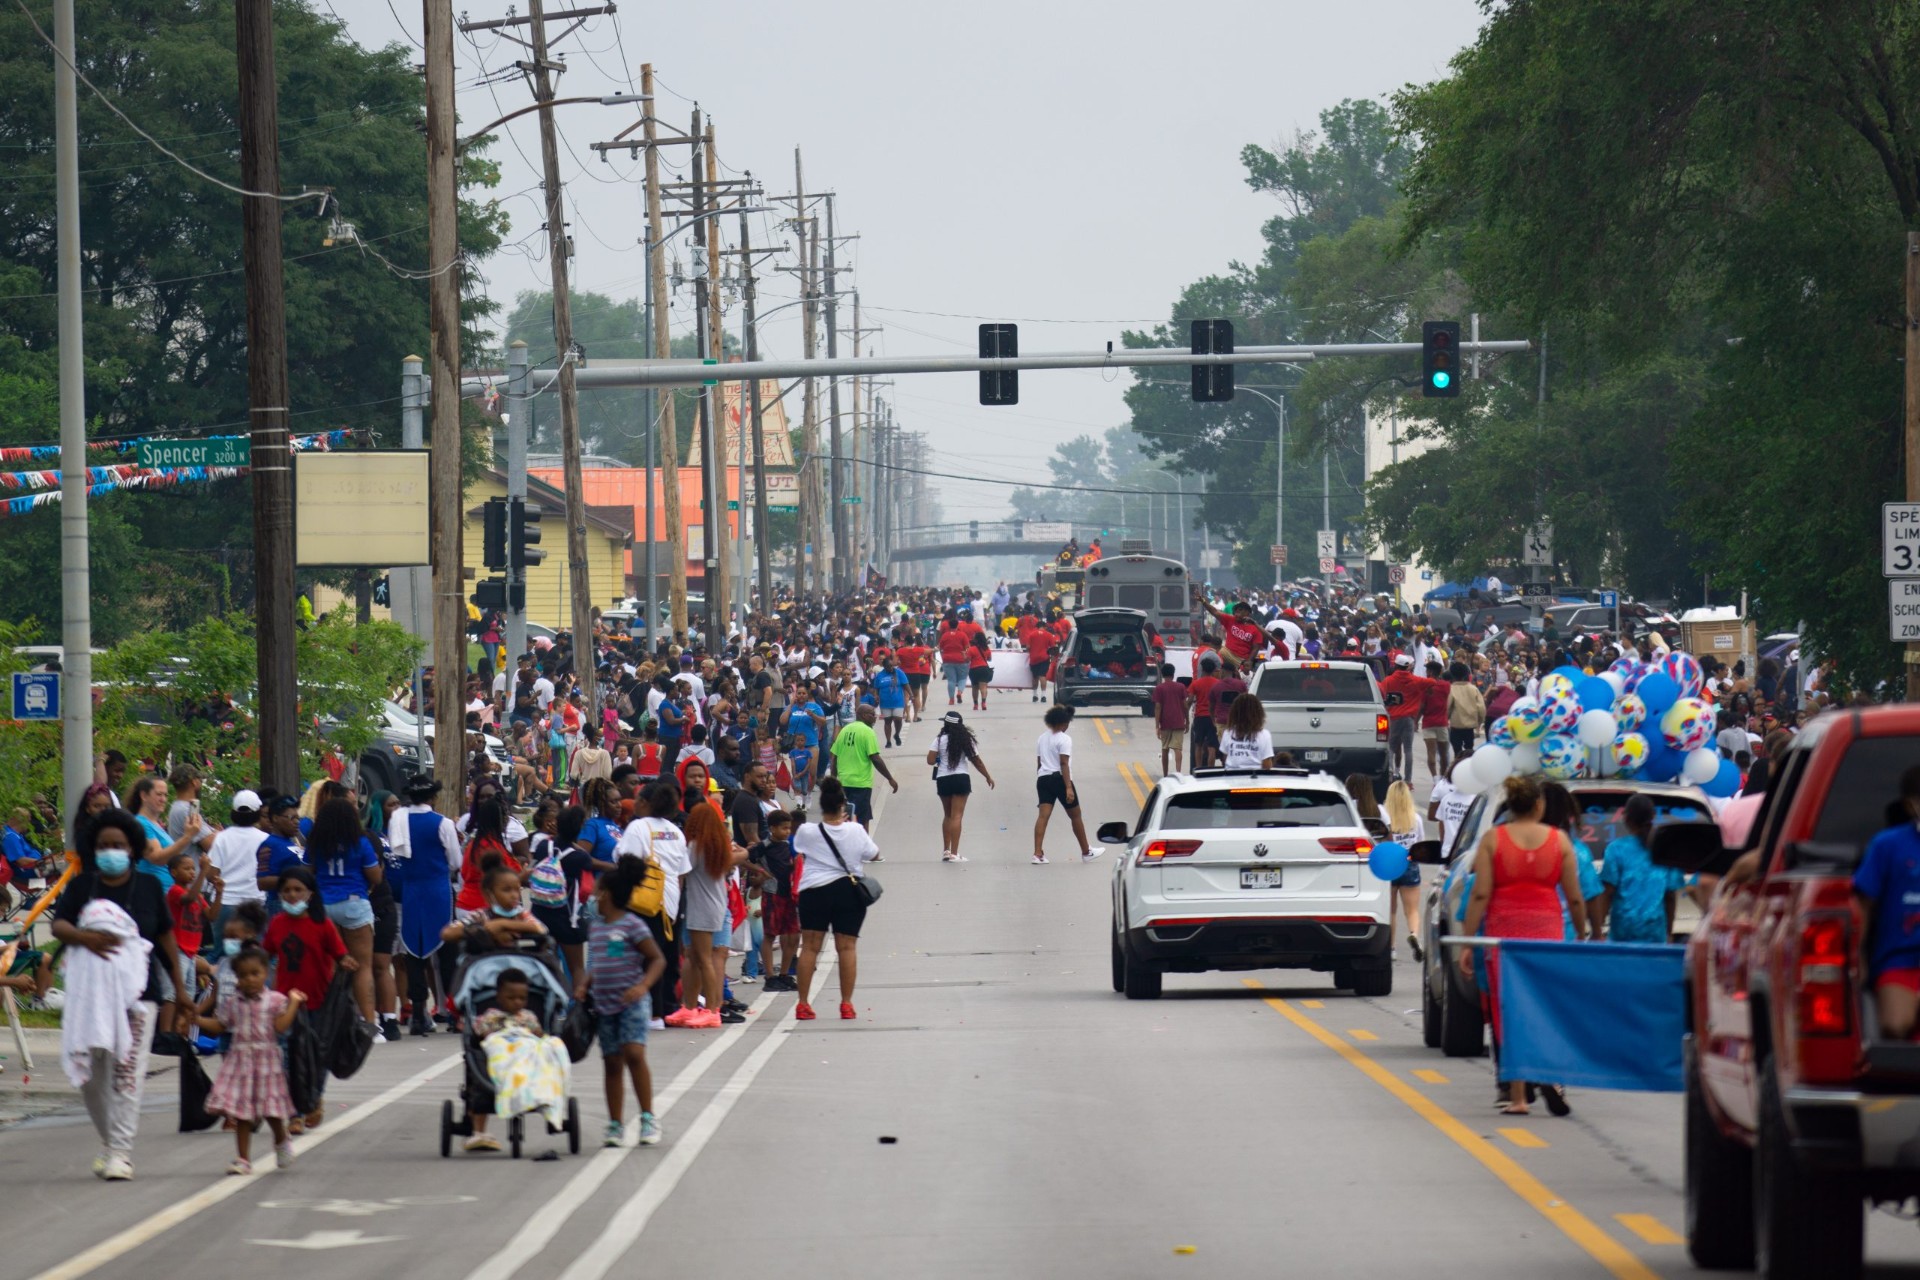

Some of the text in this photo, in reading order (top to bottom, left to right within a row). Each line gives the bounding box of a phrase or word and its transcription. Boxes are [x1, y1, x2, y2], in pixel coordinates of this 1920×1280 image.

[143, 441, 234, 467] Spencer St
[215, 453, 245, 463] 3200 N
[328, 858, 344, 876] 11
